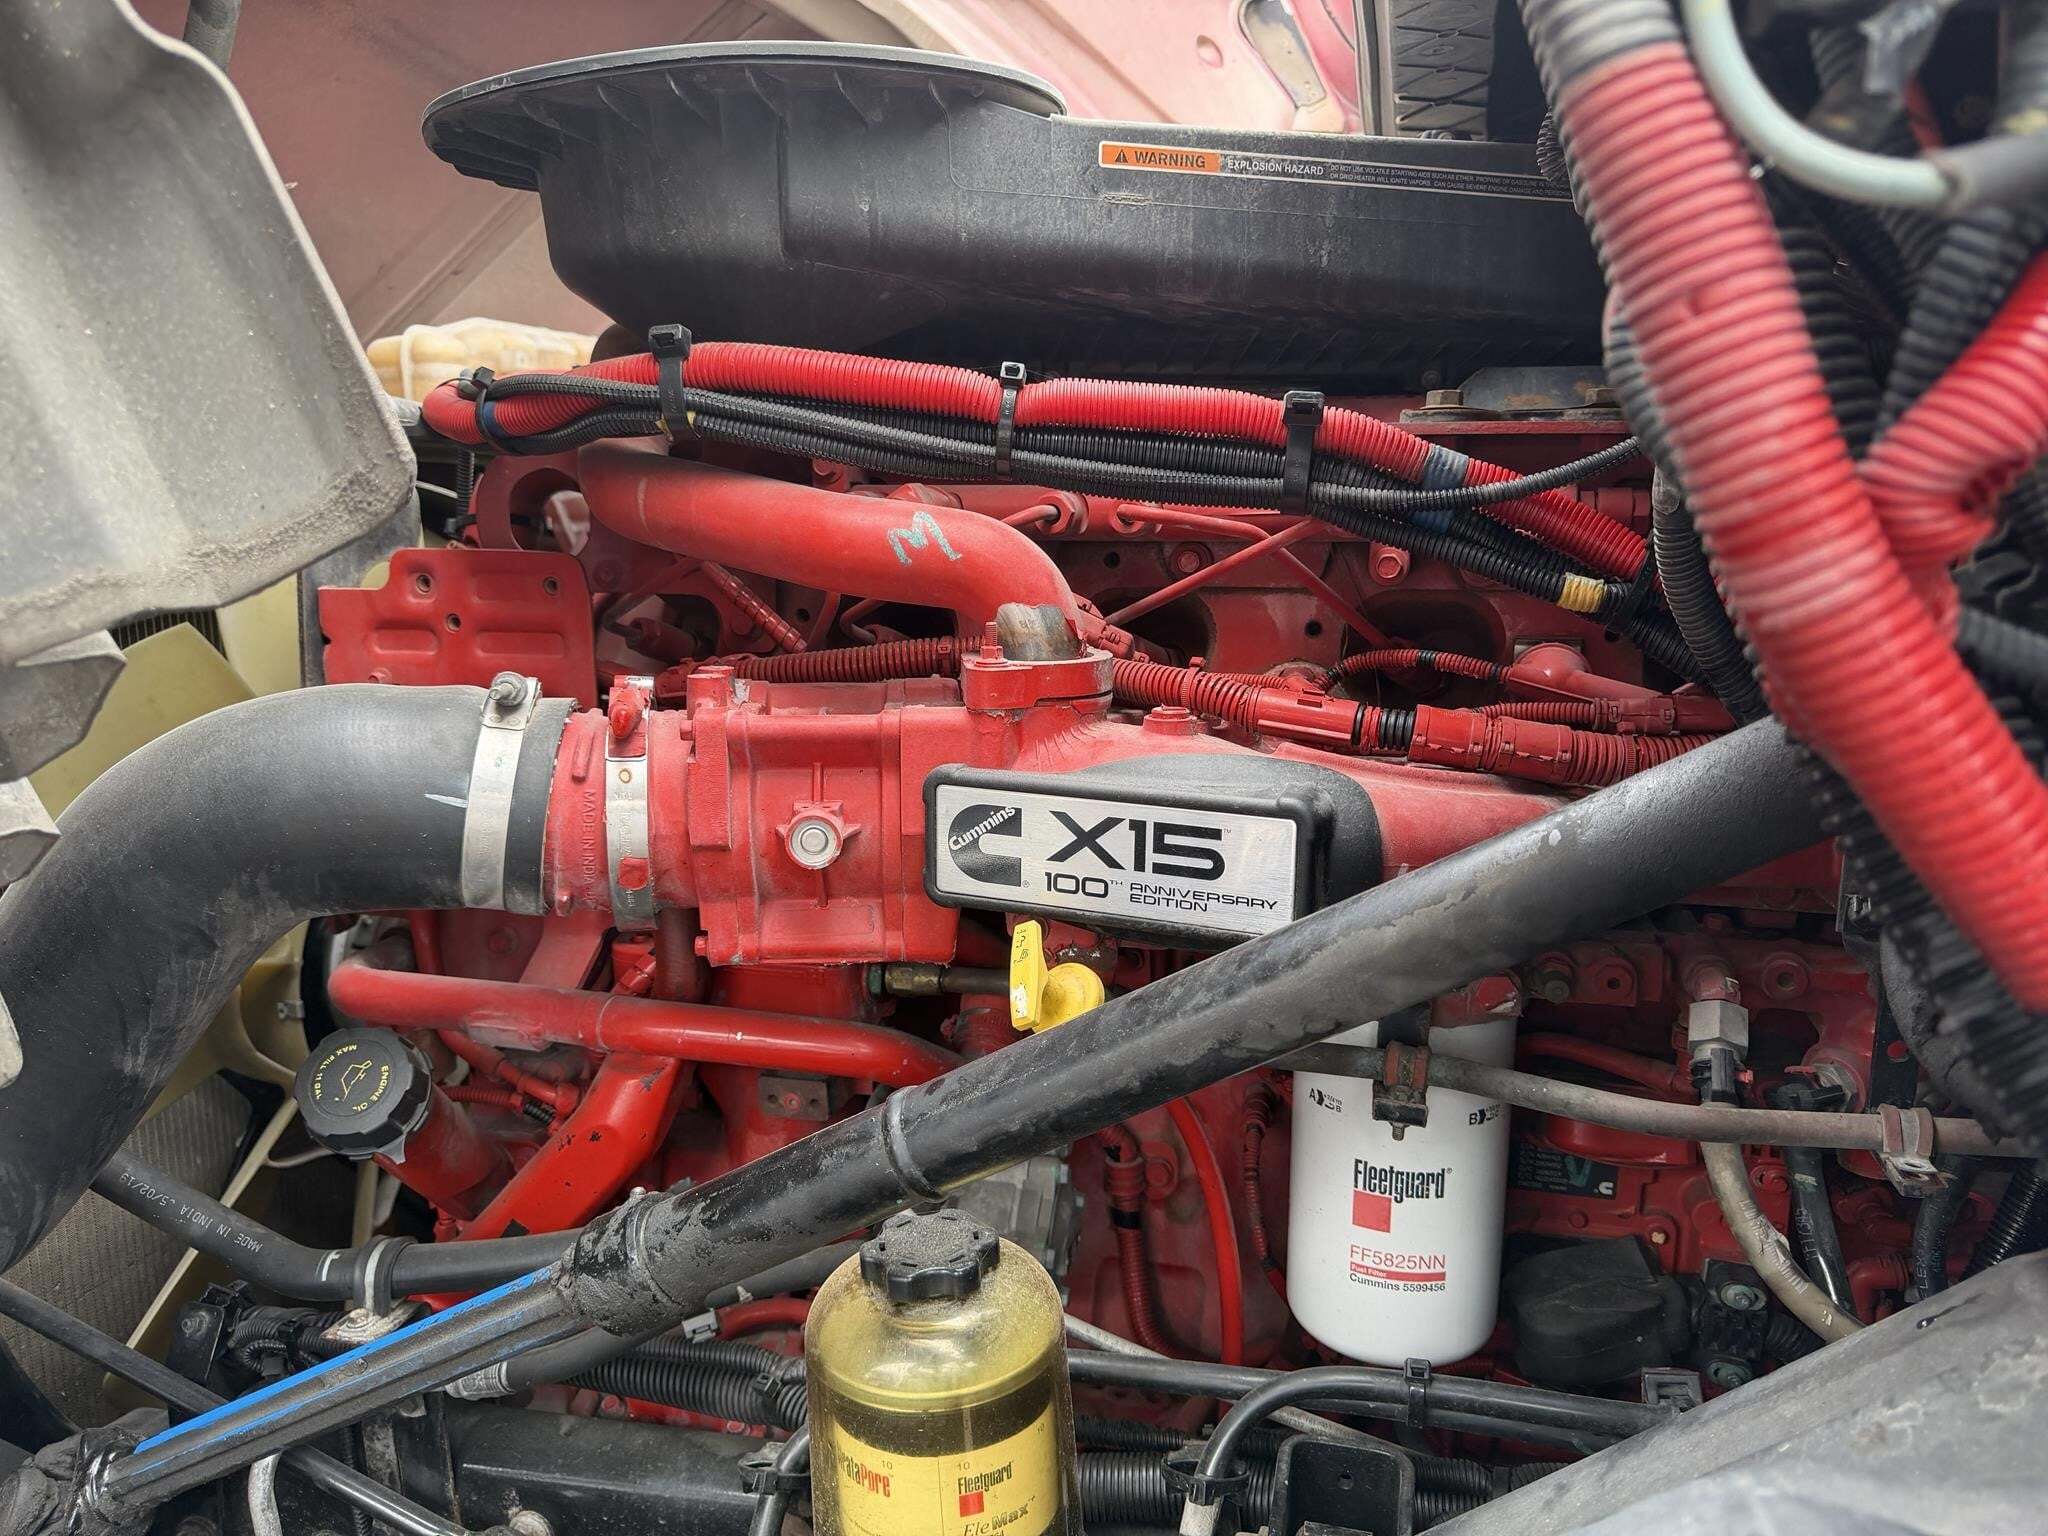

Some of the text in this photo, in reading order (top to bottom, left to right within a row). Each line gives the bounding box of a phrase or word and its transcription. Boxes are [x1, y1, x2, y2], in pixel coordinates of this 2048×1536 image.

[1134, 150, 1206, 168] WARNING
[1227, 159, 1324, 176] EXPLOSION HAZARD
[888, 511, 962, 566] M
[583, 788, 596, 832] MADE
[948, 806, 1016, 850] Cummins
[582, 836, 596, 850] IN
[1046, 810, 1226, 880] X15
[582, 854, 596, 884] INDIA
[1130, 882, 1278, 910] ANNIVERSARY
[1130, 894, 1208, 912] EDITION
[320, 1054, 335, 1070] FILL
[336, 1044, 358, 1056] MAX
[370, 1065, 390, 1102] ENGINE
[1354, 1158, 1446, 1204] Fleetguard
[119, 1172, 263, 1253] MADE IN INDIA 5/02/19
[1350, 1244, 1446, 1270] FF5825NN
[1350, 1272, 1446, 1292] Cummins 5599456
[881, 1460, 892, 1470] 10
[957, 1461, 970, 1471] 10
[958, 1462, 1012, 1495] Fleetguard
